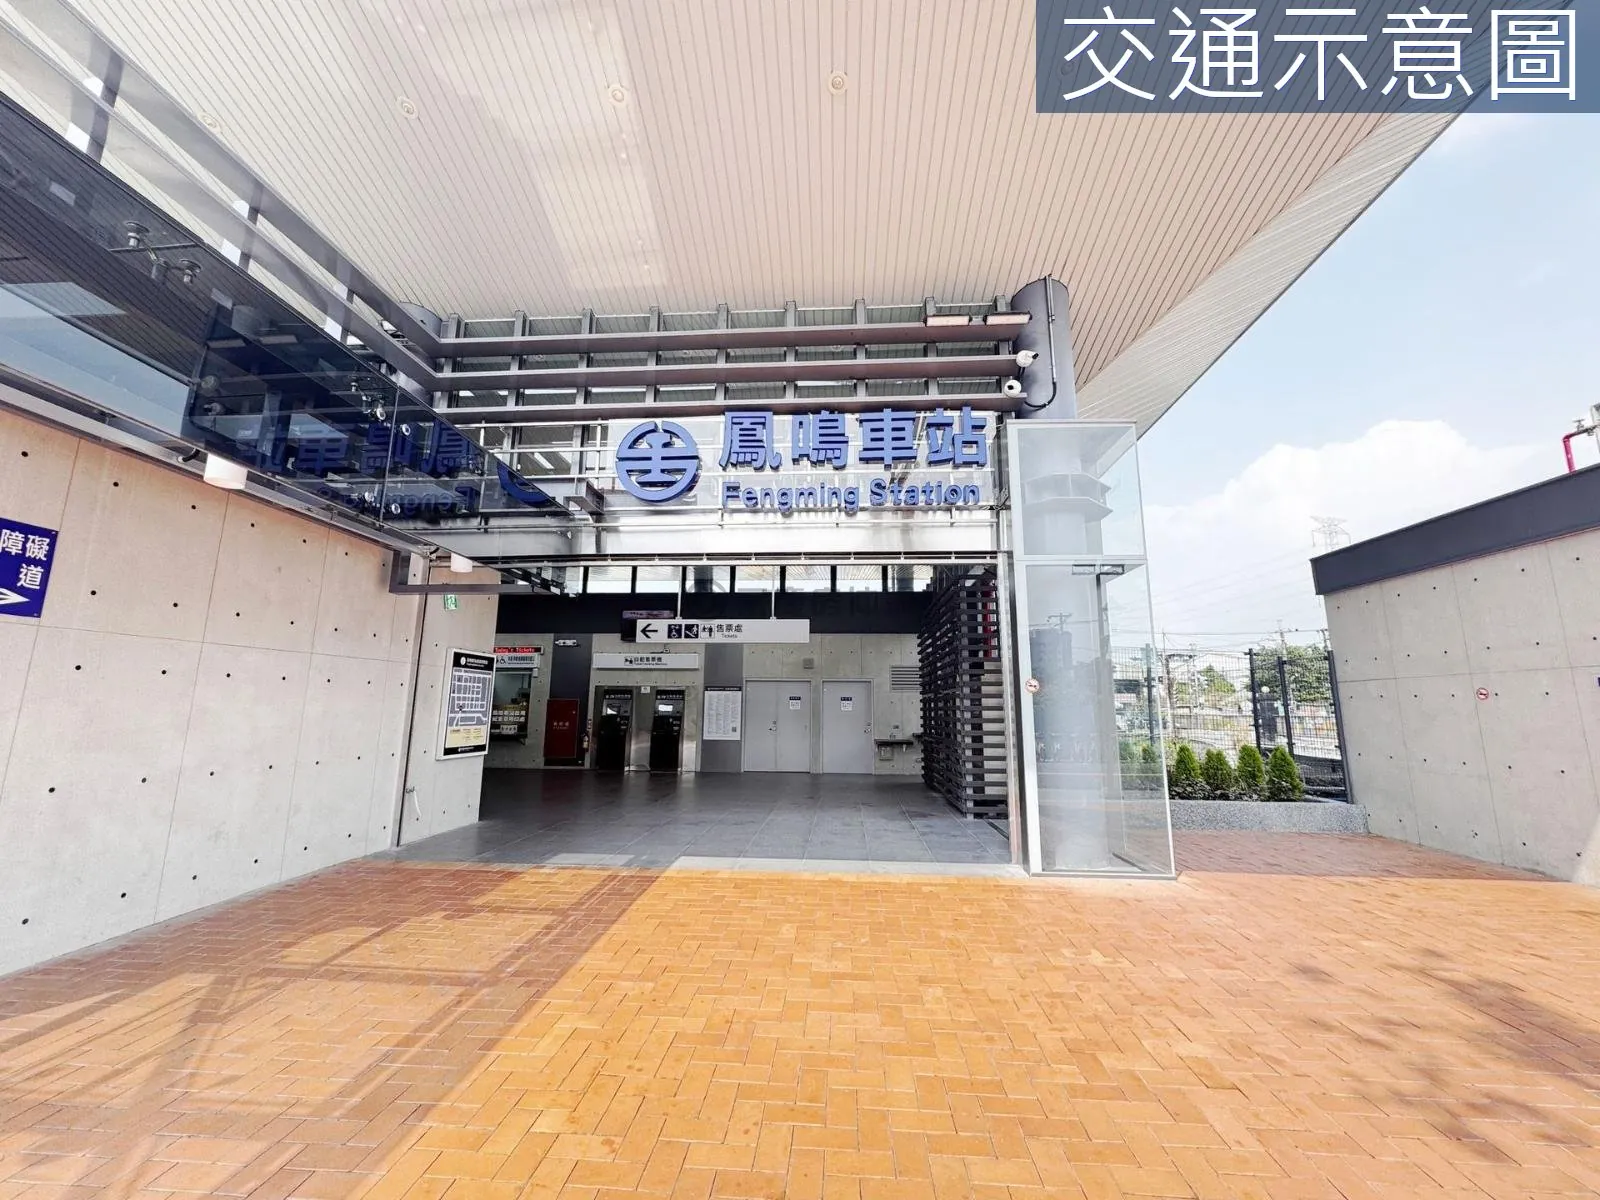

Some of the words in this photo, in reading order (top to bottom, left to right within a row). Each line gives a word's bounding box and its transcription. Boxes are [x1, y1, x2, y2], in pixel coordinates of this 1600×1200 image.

[719, 406, 988, 470] 鳳鳴車站
[722, 481, 860, 517] Fengming
[869, 478, 981, 507] Station
[0, 529, 50, 561] 障礙
[16, 563, 44, 590] 道
